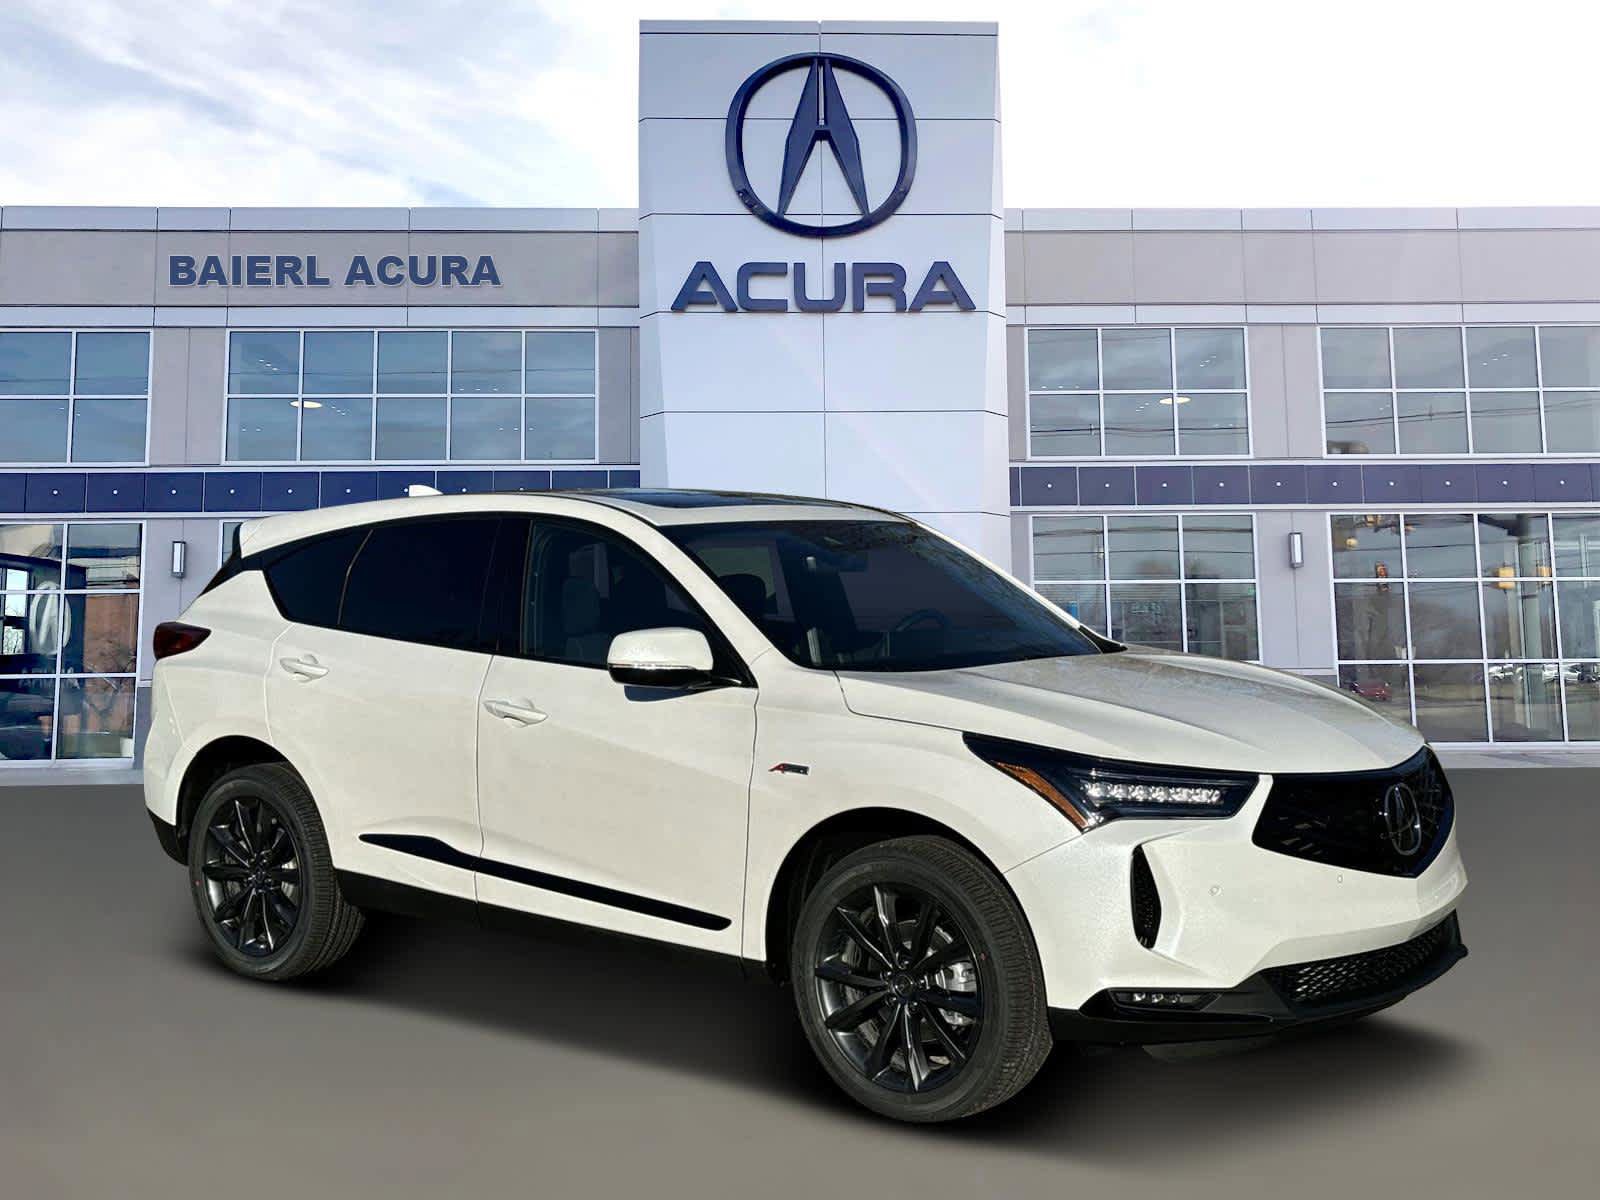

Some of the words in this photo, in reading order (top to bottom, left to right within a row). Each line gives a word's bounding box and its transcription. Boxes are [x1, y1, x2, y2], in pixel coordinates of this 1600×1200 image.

[169, 255, 330, 286] BAIERL
[345, 255, 501, 286] ACURA
[671, 261, 976, 313] ACURA
